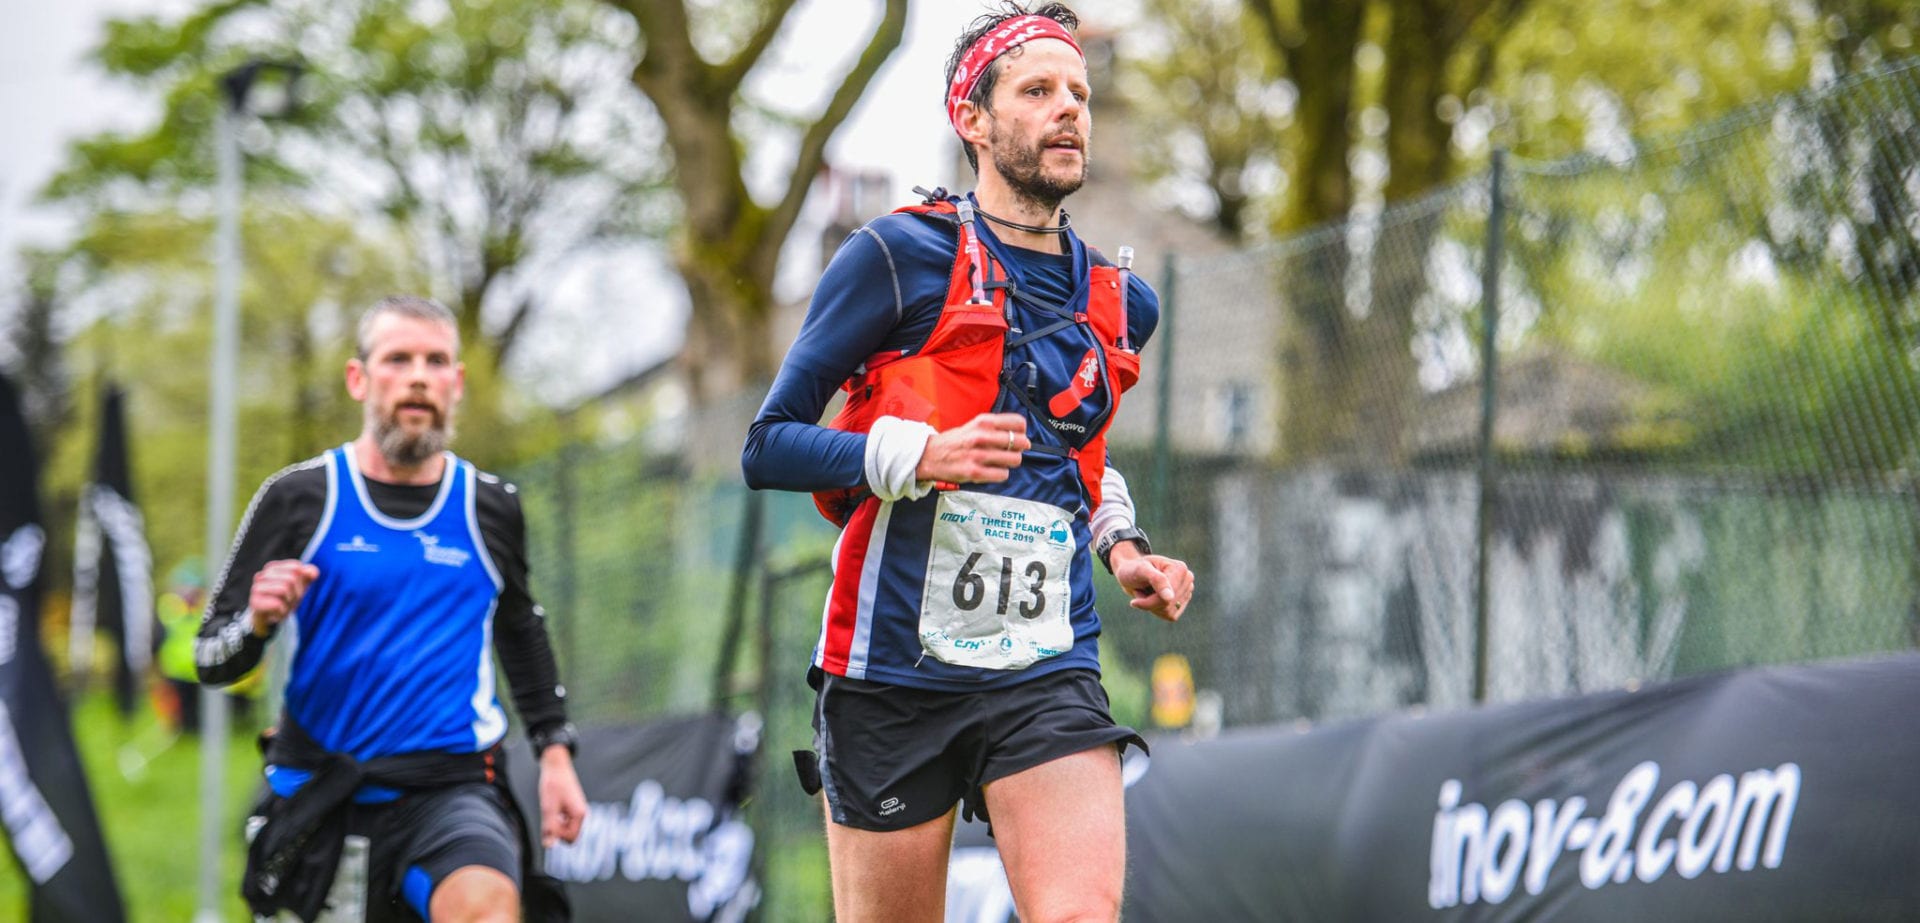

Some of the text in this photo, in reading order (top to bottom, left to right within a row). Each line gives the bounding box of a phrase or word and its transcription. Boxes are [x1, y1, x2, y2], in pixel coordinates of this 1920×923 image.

[1001, 510, 1026, 521] 65TH
[981, 516, 1046, 534] THREE PEAKS
[984, 528, 1035, 543] RACE 2019
[952, 552, 1047, 619] 613
[1428, 760, 1801, 910] inov-8.com
